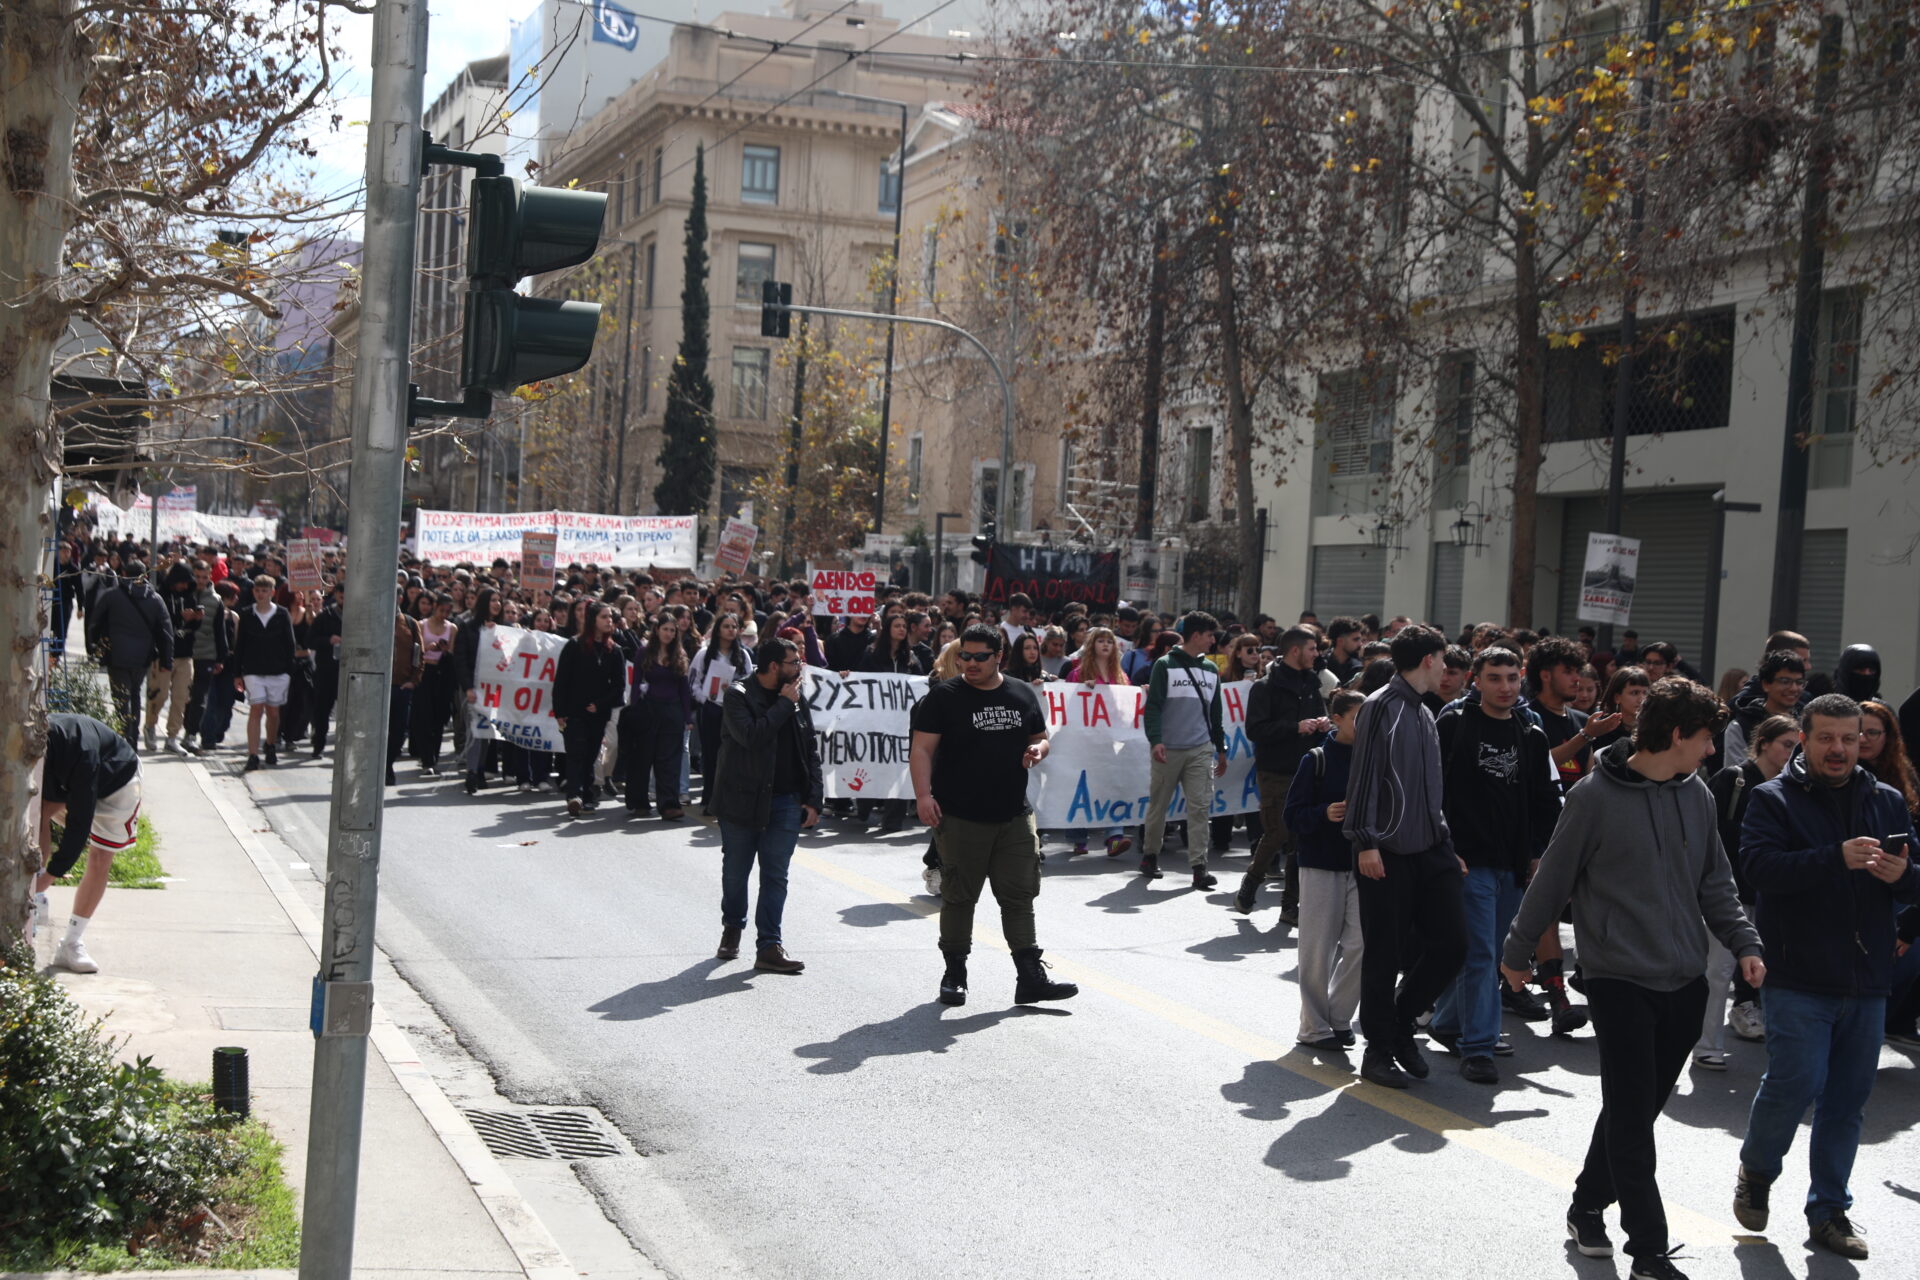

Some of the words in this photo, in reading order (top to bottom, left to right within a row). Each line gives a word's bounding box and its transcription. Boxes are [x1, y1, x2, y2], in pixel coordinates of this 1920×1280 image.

[423, 513, 436, 526] ΤΟ
[441, 513, 501, 527] ΣΥΣΤΗΜΑ
[578, 515, 592, 529] ΜΕ
[595, 518, 622, 530] ΑΙΜΑ
[629, 519, 692, 530] ΠΟΤΙΣΜΕΝΟ
[422, 530, 449, 543] ΠΟΤΕ
[453, 531, 464, 543] ΔΕ
[467, 531, 481, 543] ΘΑ
[562, 529, 609, 541] ΕΓΚΛΗΜΑ
[614, 531, 634, 543] ΣΤΟ
[636, 530, 673, 542] ΤΡΕΝΟ
[1020, 548, 1091, 577] ΗΤΑΝ
[812, 571, 846, 591] ΔΕΝ
[518, 652, 556, 683] ΤΑ
[513, 686, 544, 715] ΟΙ
[808, 673, 917, 712] ΣΥΣΤΗΜΑ
[972, 709, 1022, 724] AUTHENTIC
[1077, 691, 1112, 728] ΤΑ
[511, 723, 543, 739] ΓΕΛ
[974, 717, 996, 729] VINTAGE
[997, 717, 1023, 727] SUPPLIES
[815, 730, 867, 765] ΜΕΝΟ
